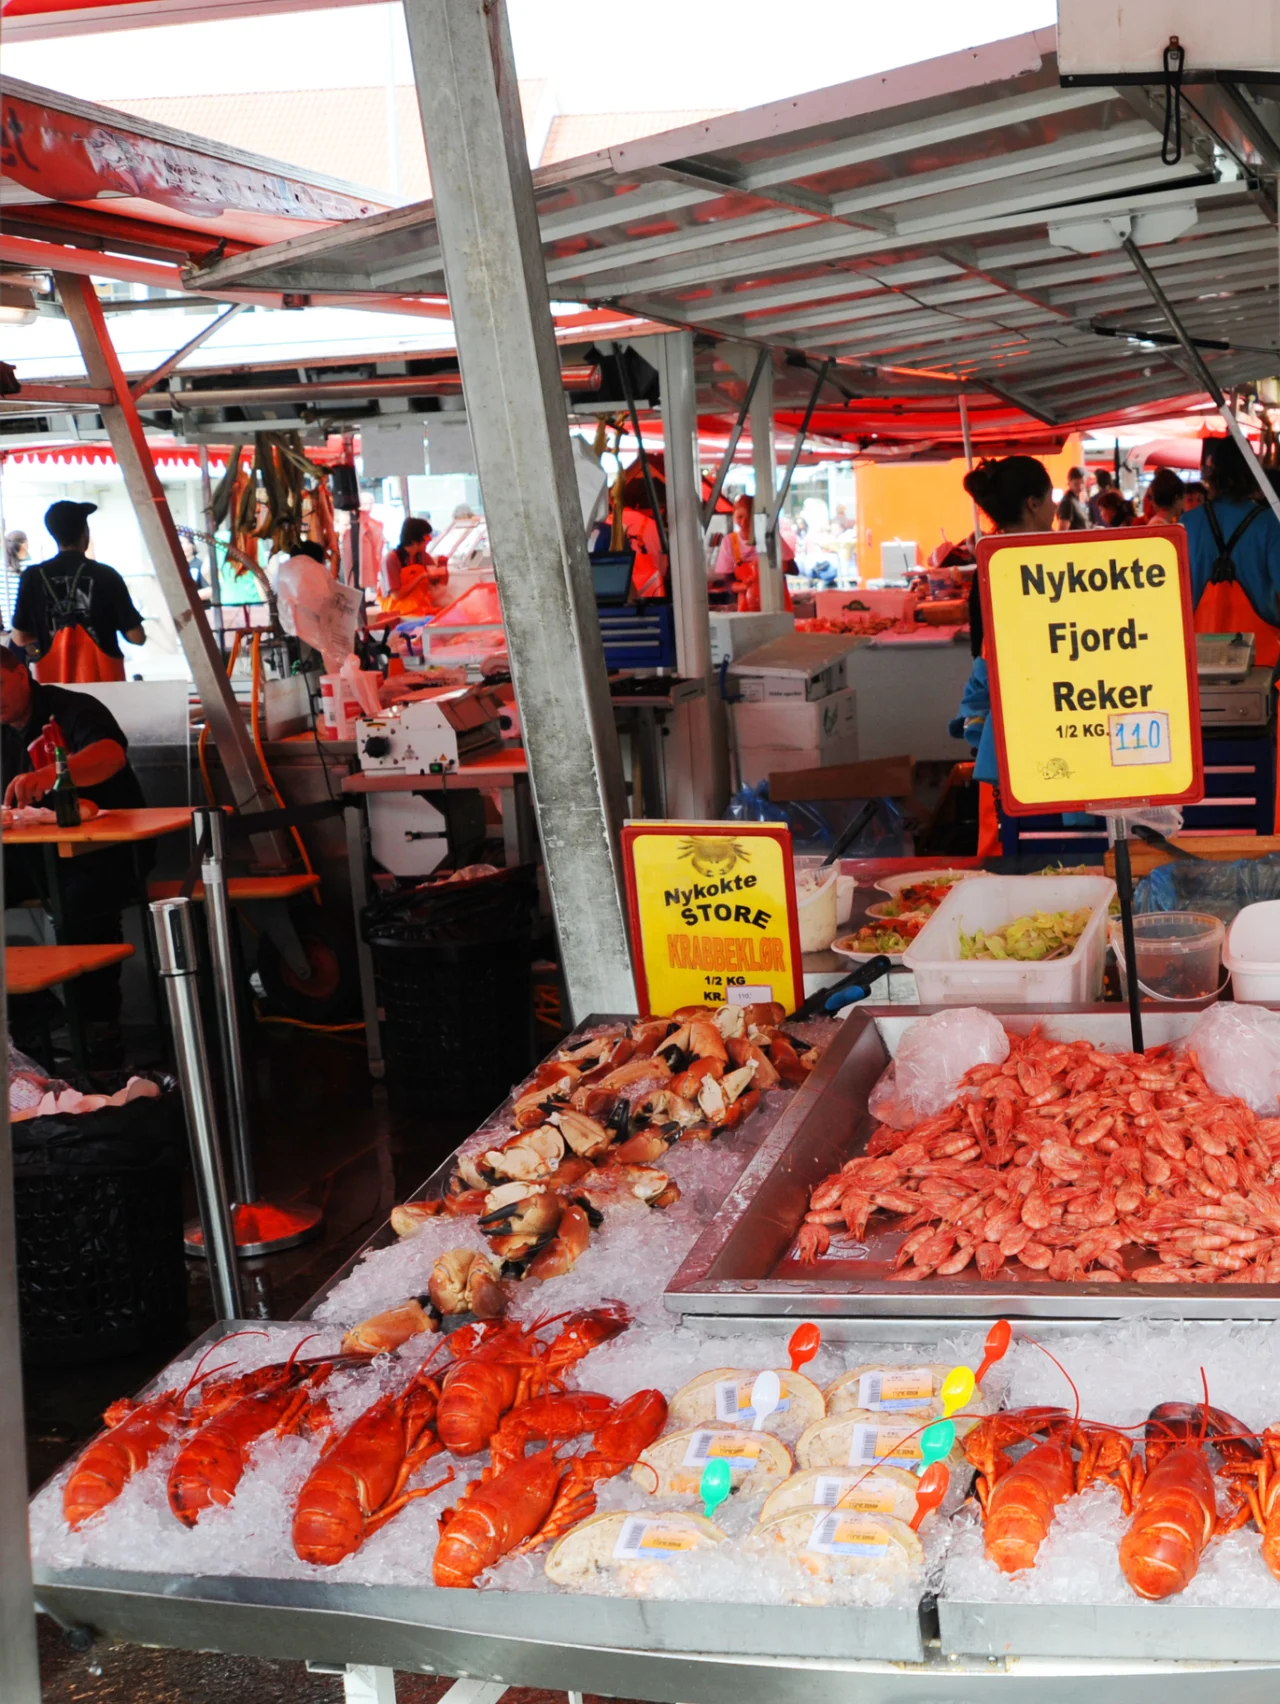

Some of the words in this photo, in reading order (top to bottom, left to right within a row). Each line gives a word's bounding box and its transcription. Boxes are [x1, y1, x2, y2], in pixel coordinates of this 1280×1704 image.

[1020, 557, 1166, 603] Nykokte
[1048, 618, 1148, 662] Fjord-
[1053, 680, 1153, 712] Reker
[1056, 725, 1078, 738] 1/2
[1115, 720, 1161, 750] 110
[664, 875, 757, 907] Nykokte
[681, 904, 772, 930] STORE
[667, 934, 786, 973] KRABBEKLØR
[704, 976, 722, 986] 1/2
[727, 976, 746, 986] KG
[704, 991, 725, 1002] KR.
